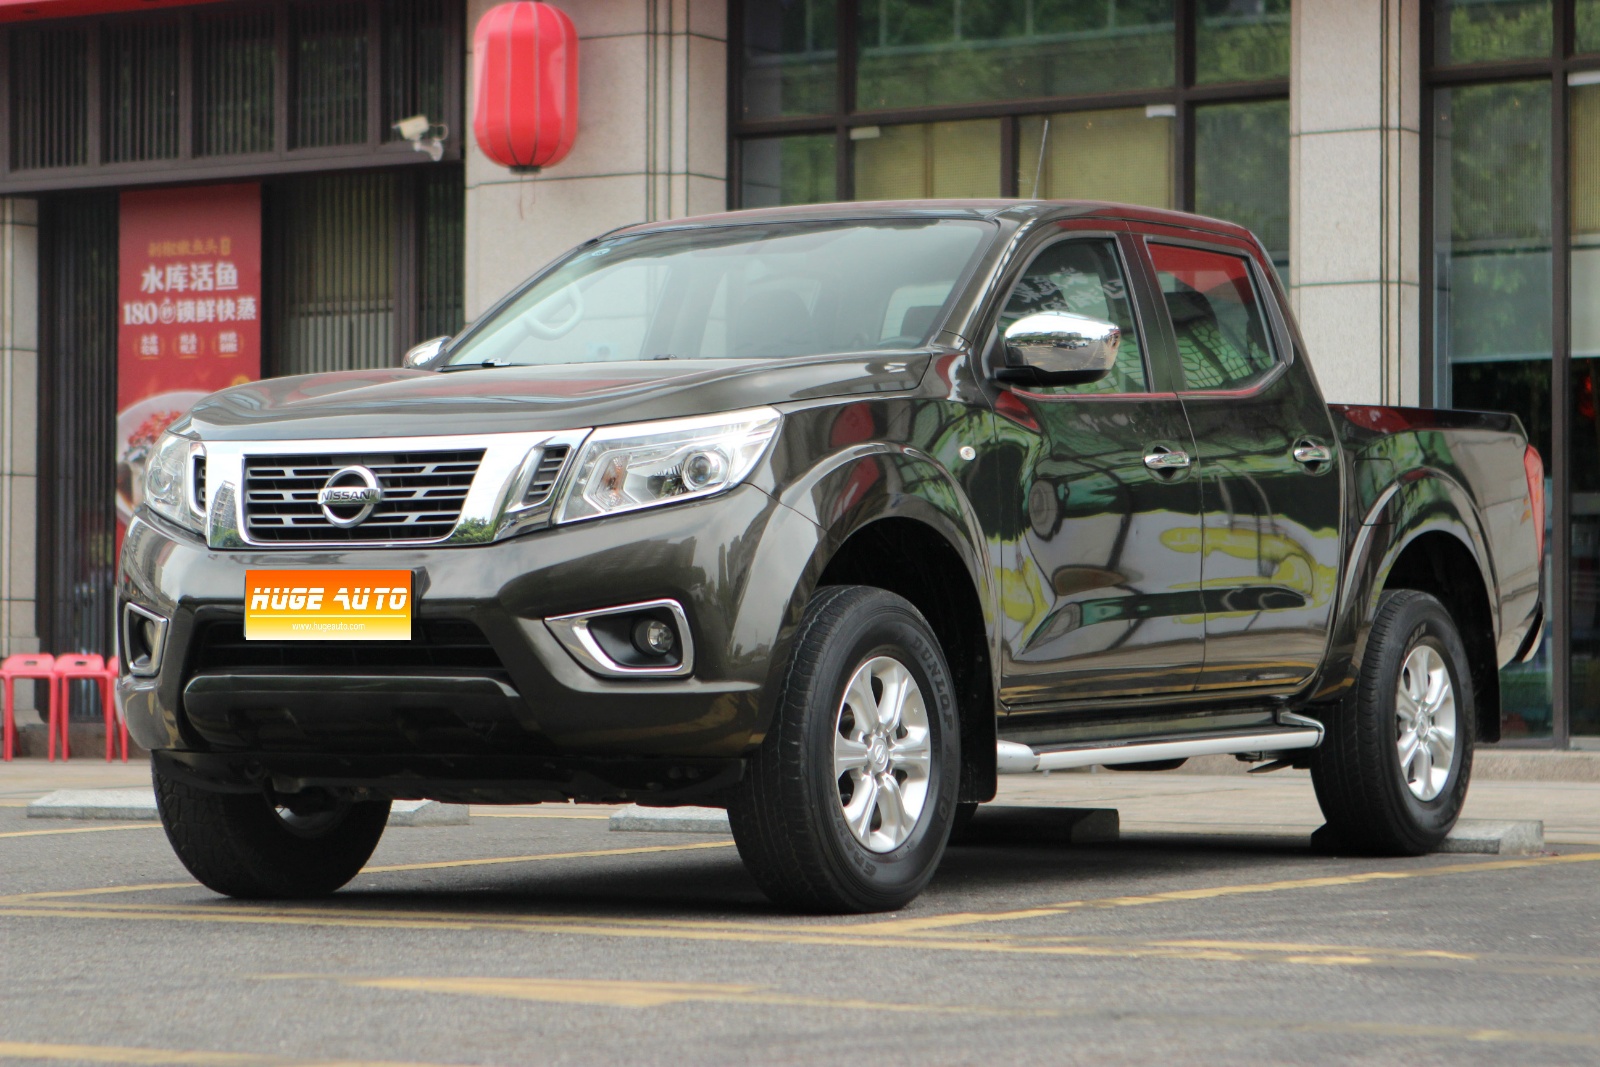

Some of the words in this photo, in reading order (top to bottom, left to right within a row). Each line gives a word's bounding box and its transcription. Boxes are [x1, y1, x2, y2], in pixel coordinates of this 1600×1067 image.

[140, 262, 239, 294] 水库活鱼
[321, 490, 371, 500] NISSAN
[912, 635, 954, 731] DUNLOP
